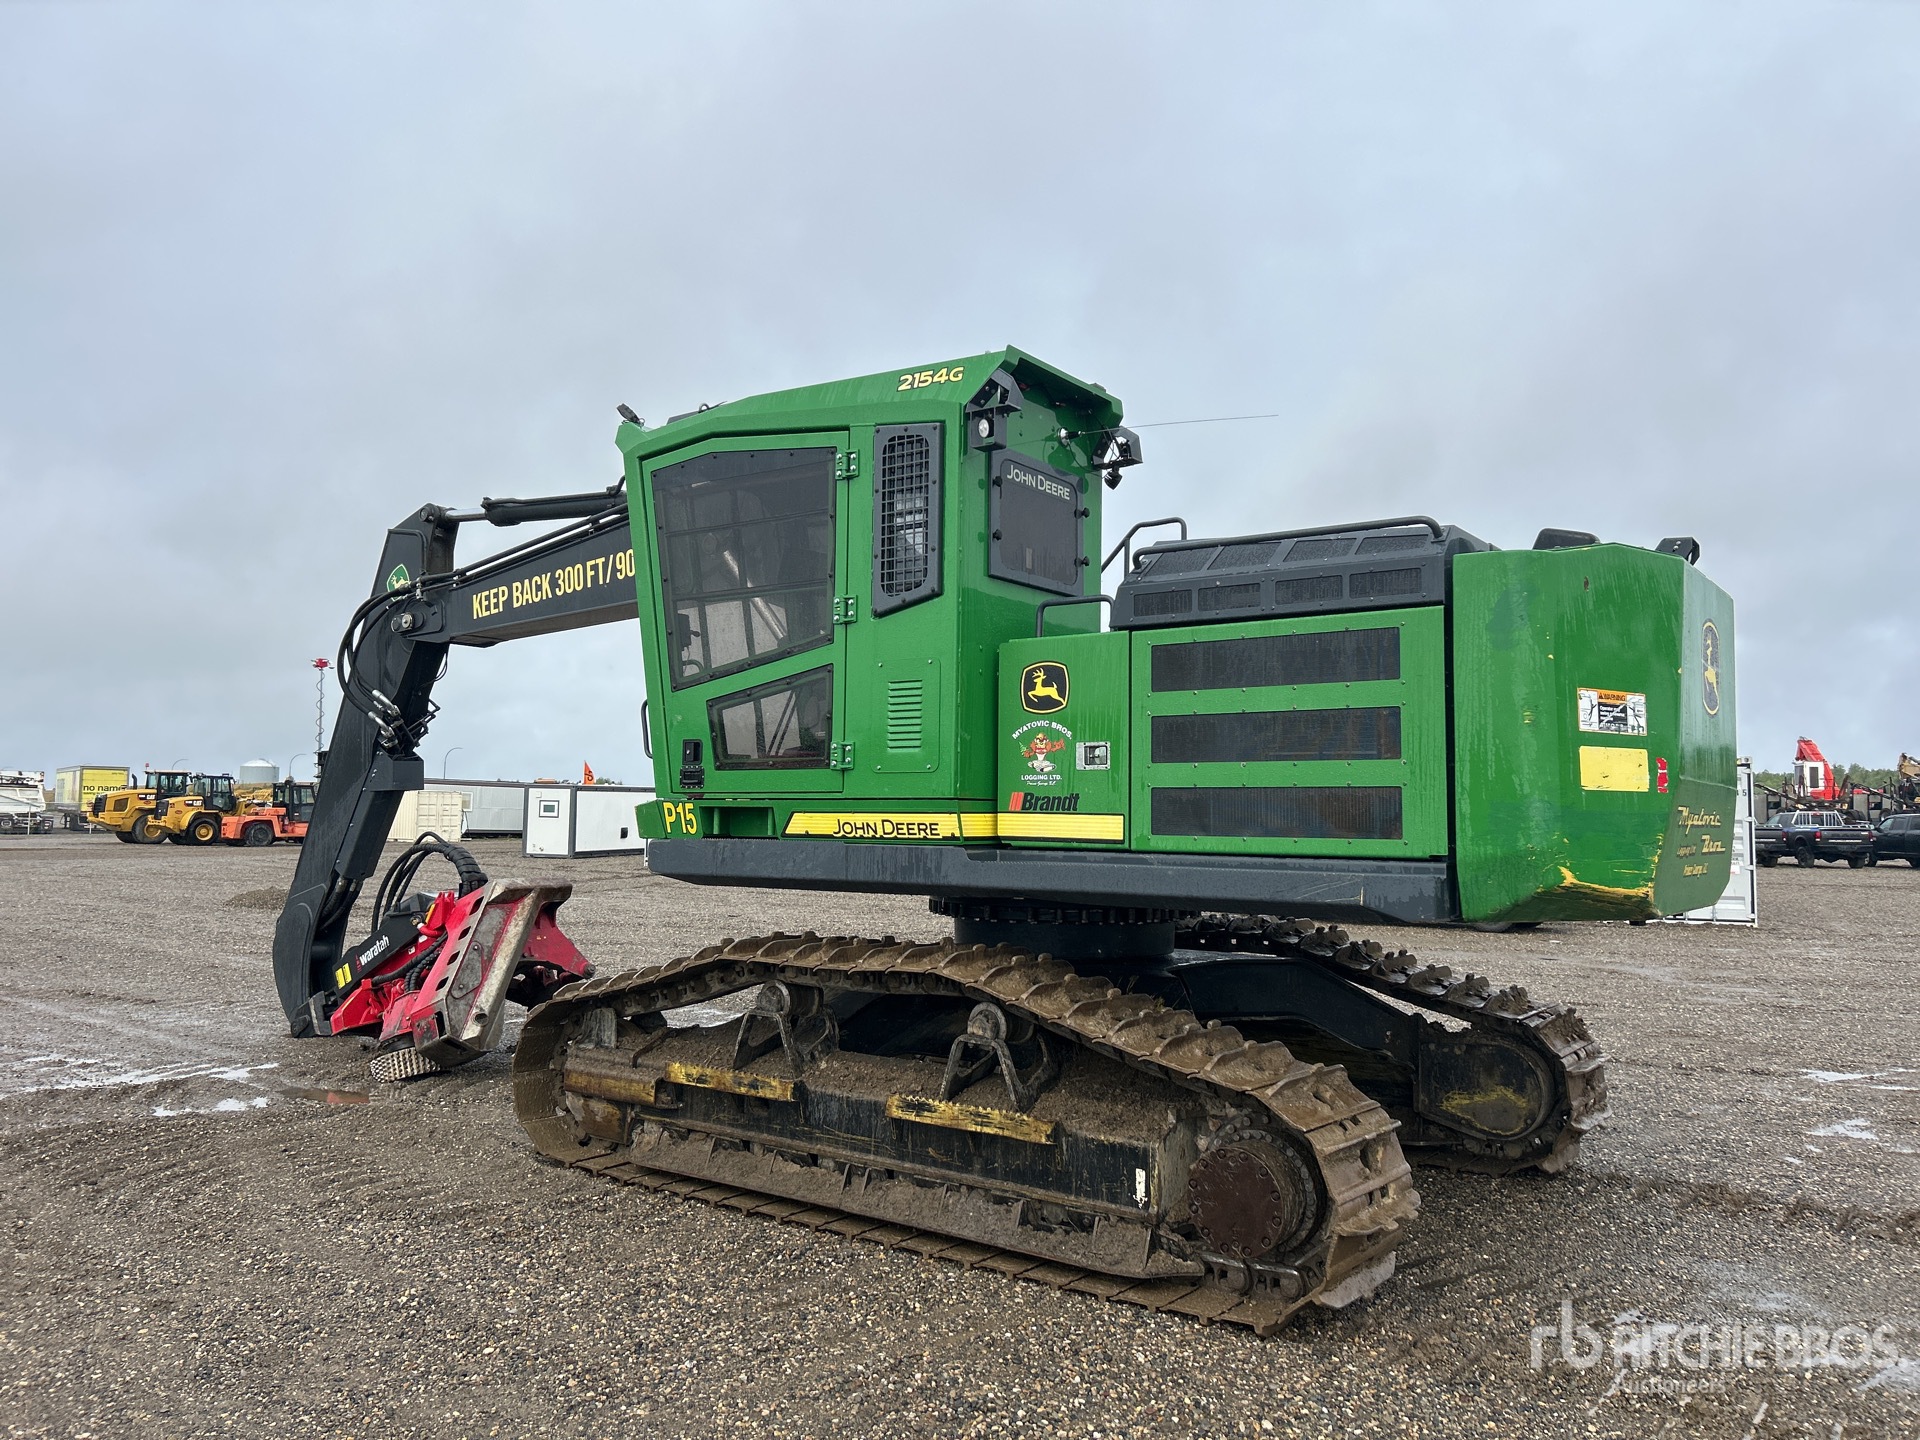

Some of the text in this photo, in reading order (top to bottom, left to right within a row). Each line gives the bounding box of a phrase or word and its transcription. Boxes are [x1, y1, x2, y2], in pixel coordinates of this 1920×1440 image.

[896, 366, 965, 392] 2154G
[1006, 464, 1071, 501] JOHN DEERE
[472, 585, 509, 620] KEEP
[512, 572, 553, 609] BACK
[555, 563, 584, 597] 300
[1012, 719, 1050, 740] MYATOVIC
[1021, 792, 1080, 811] Brandt
[662, 801, 698, 835] P15
[832, 818, 941, 838] JOHN DEERE
[359, 935, 390, 966] waratah
